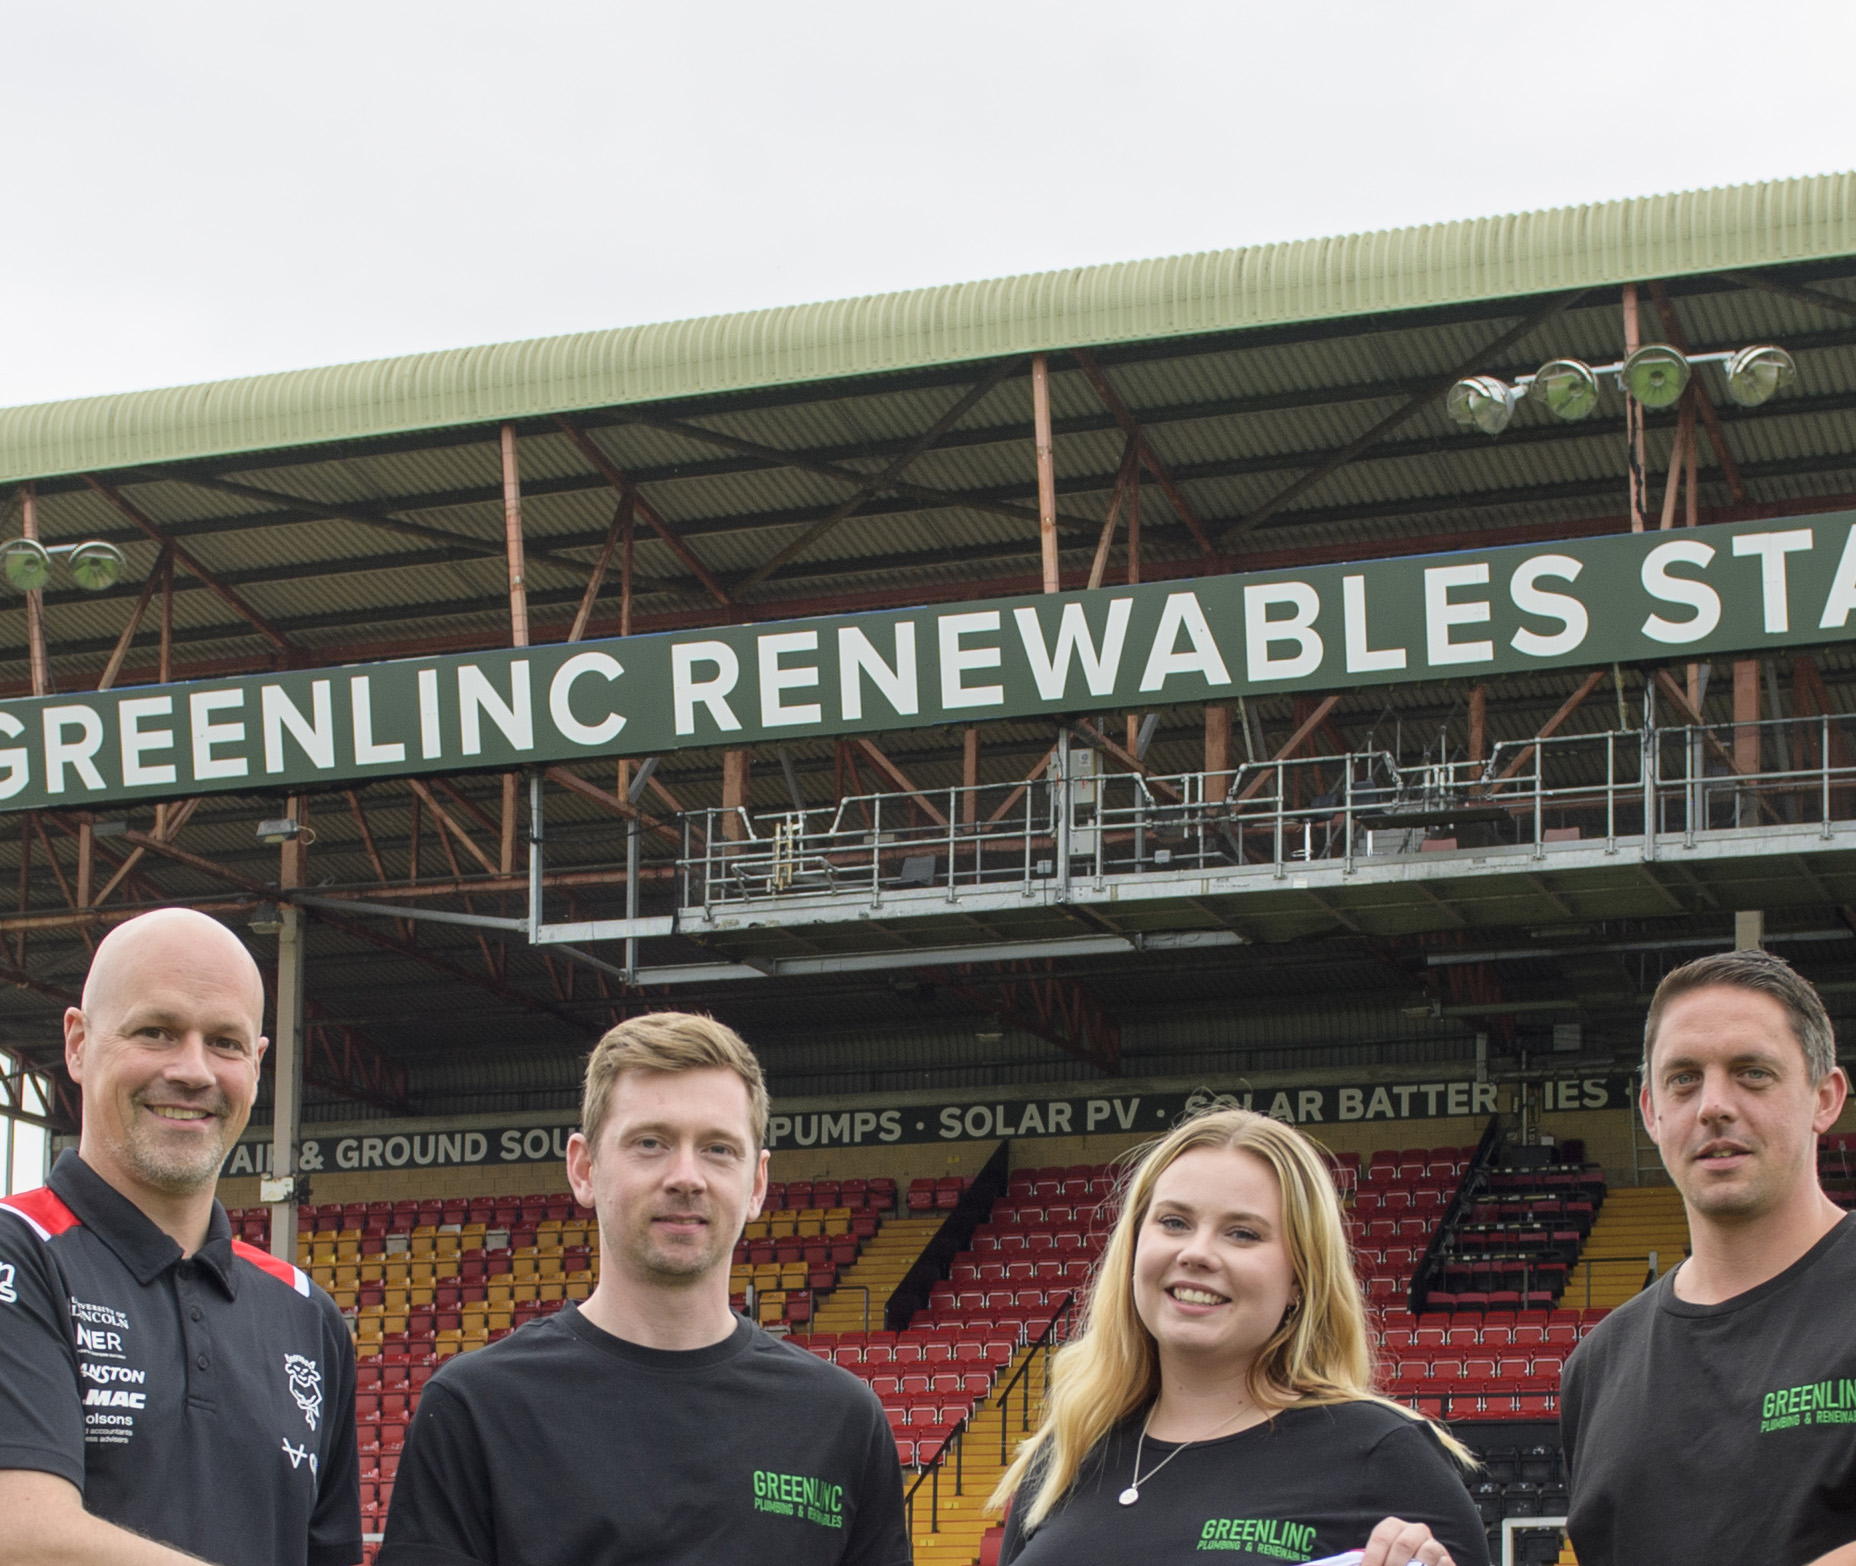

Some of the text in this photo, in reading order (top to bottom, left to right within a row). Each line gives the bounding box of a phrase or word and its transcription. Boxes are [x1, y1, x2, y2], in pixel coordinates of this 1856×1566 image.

[671, 553, 1590, 736] RENEWABLES
[299, 1140, 324, 1171] &
[335, 1132, 488, 1169] GROUND
[769, 1109, 902, 1147] PUMPS
[939, 1102, 1073, 1139] SOLAR
[1087, 1098, 1141, 1131] PV
[83, 1388, 146, 1409] MAC
[753, 1470, 843, 1512] GREENLINC
[1197, 1540, 1241, 1551] PLUMBING
[1201, 1518, 1317, 1552] GREENLINC
